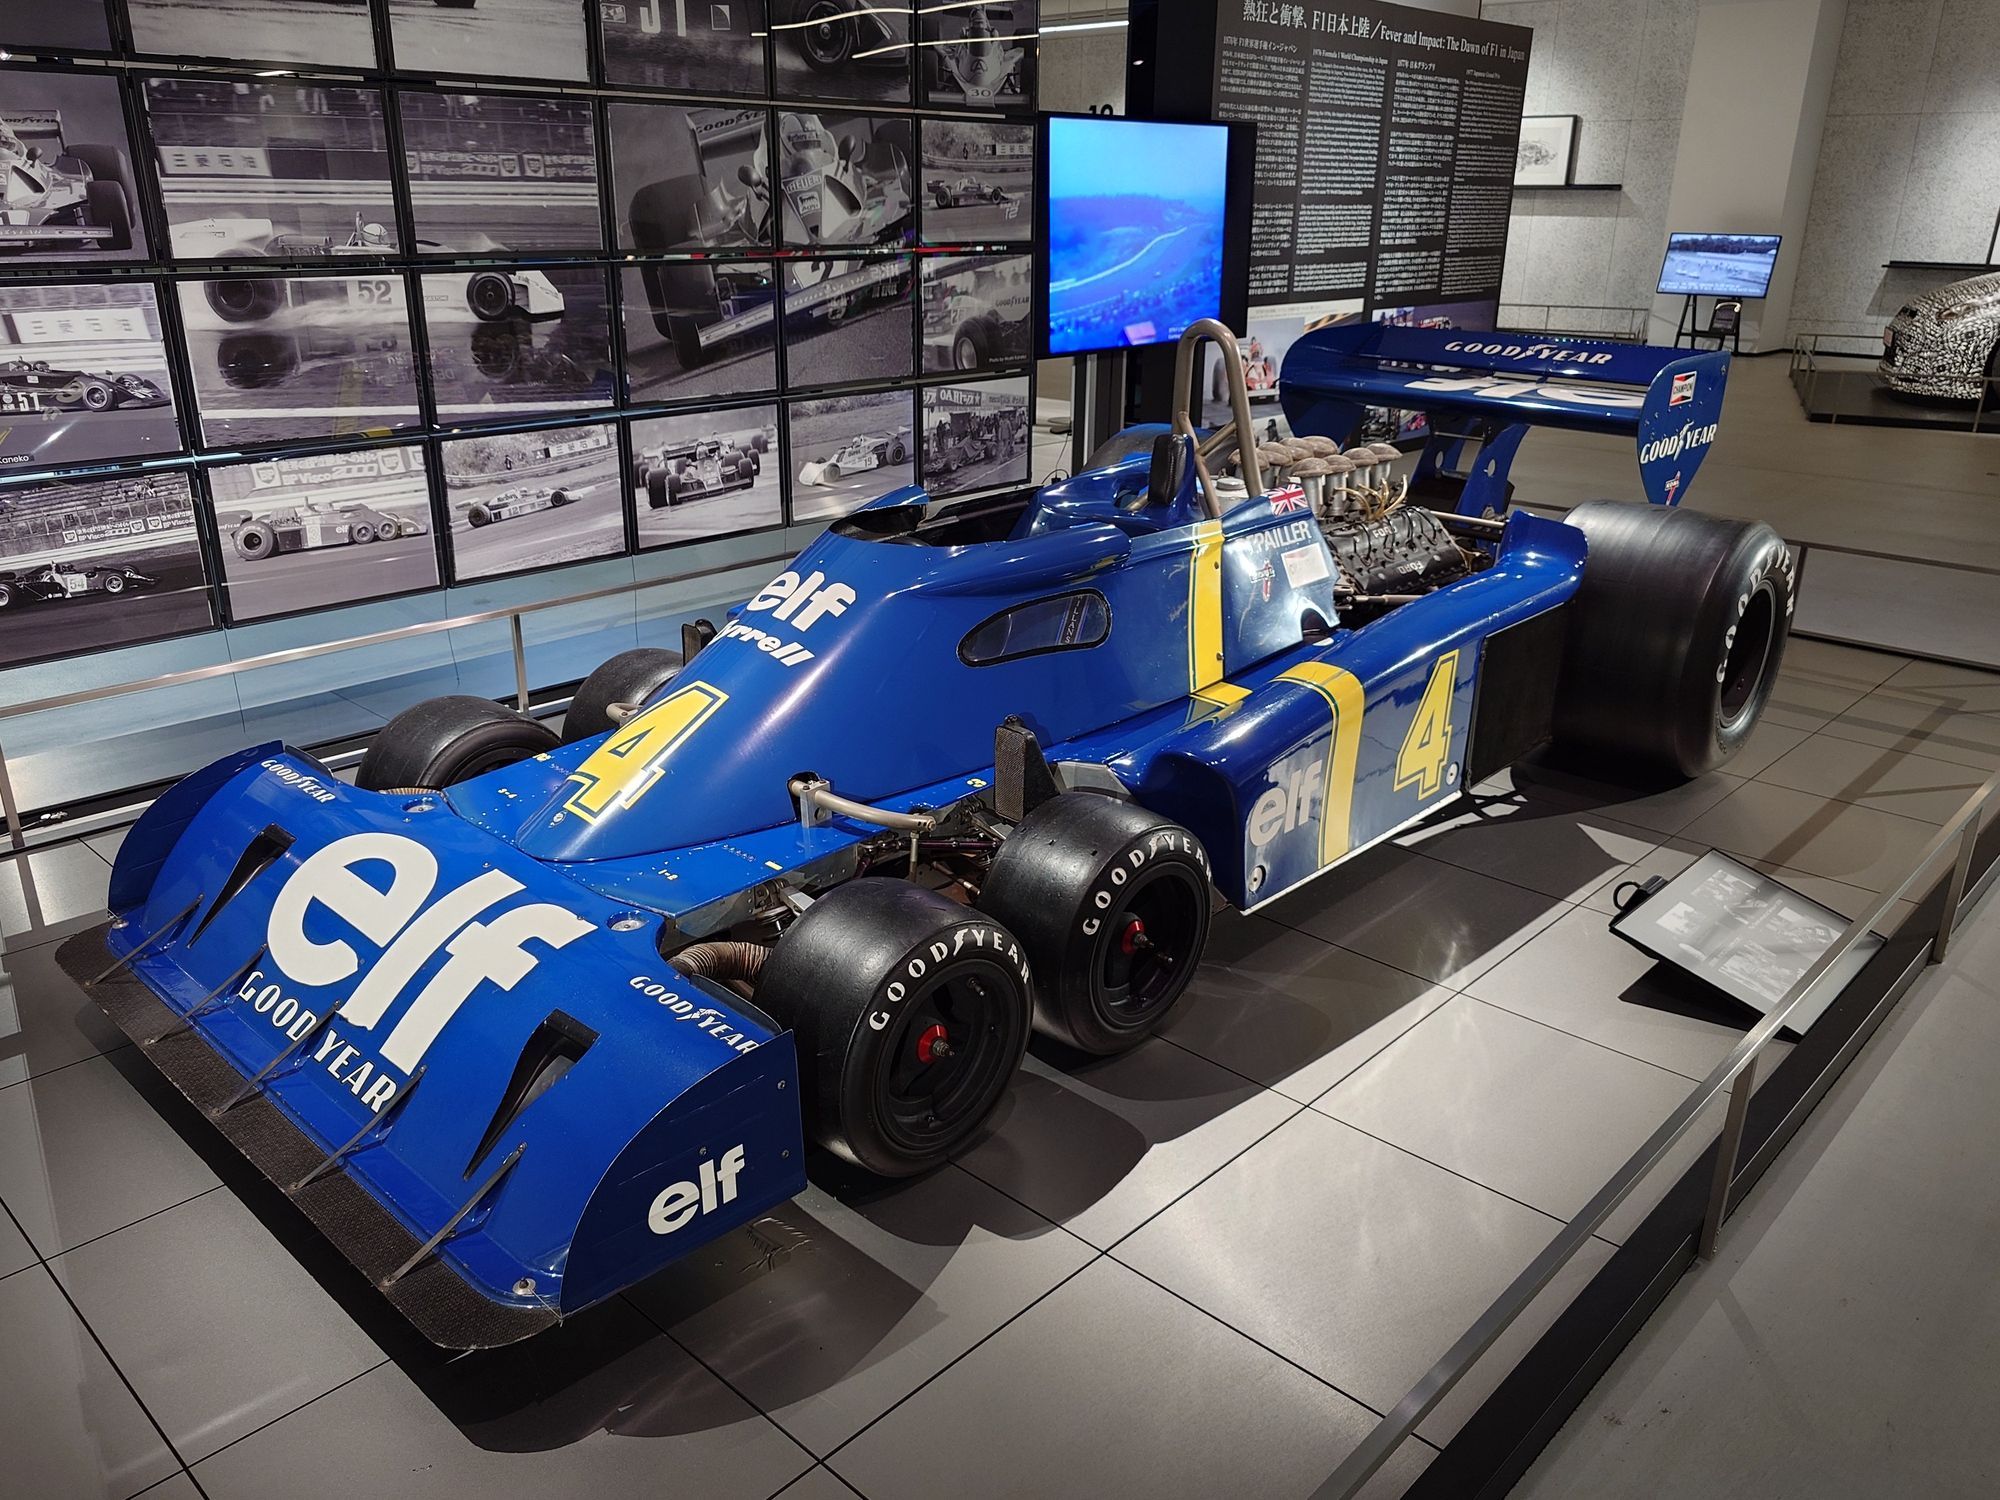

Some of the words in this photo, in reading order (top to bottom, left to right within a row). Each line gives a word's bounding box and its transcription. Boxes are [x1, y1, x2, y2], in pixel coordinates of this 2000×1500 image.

[1380, 25, 1402, 43] Fever
[1403, 31, 1418, 45] and
[1418, 32, 1446, 50] Impact:
[1446, 36, 1459, 51] The
[1461, 38, 1480, 54] Dawn
[1481, 42, 1490, 55] of
[1490, 43, 1499, 56] F1
[1500, 45, 1507, 58] in
[1507, 47, 1525, 63] Japan
[969, 88, 993, 97] 30
[358, 280, 392, 304] 52
[1444, 341, 1613, 365] GOODYEAR
[17, 392, 41, 411] 51
[1640, 421, 1717, 464] GOODYEAR
[336, 524, 349, 534] elf
[1398, 561, 1424, 574] FORD
[746, 570, 856, 632] elf
[1393, 649, 1460, 800] 4
[563, 681, 729, 826] 4
[260, 759, 336, 804] GOODYEAR
[1250, 760, 1323, 848] elf
[1082, 834, 1213, 936] GOODYEAR
[267, 832, 599, 1076] elf
[869, 927, 1031, 1031] GOODYEAR
[629, 976, 760, 1054] GOODYEAR
[648, 1144, 746, 1235] elf
